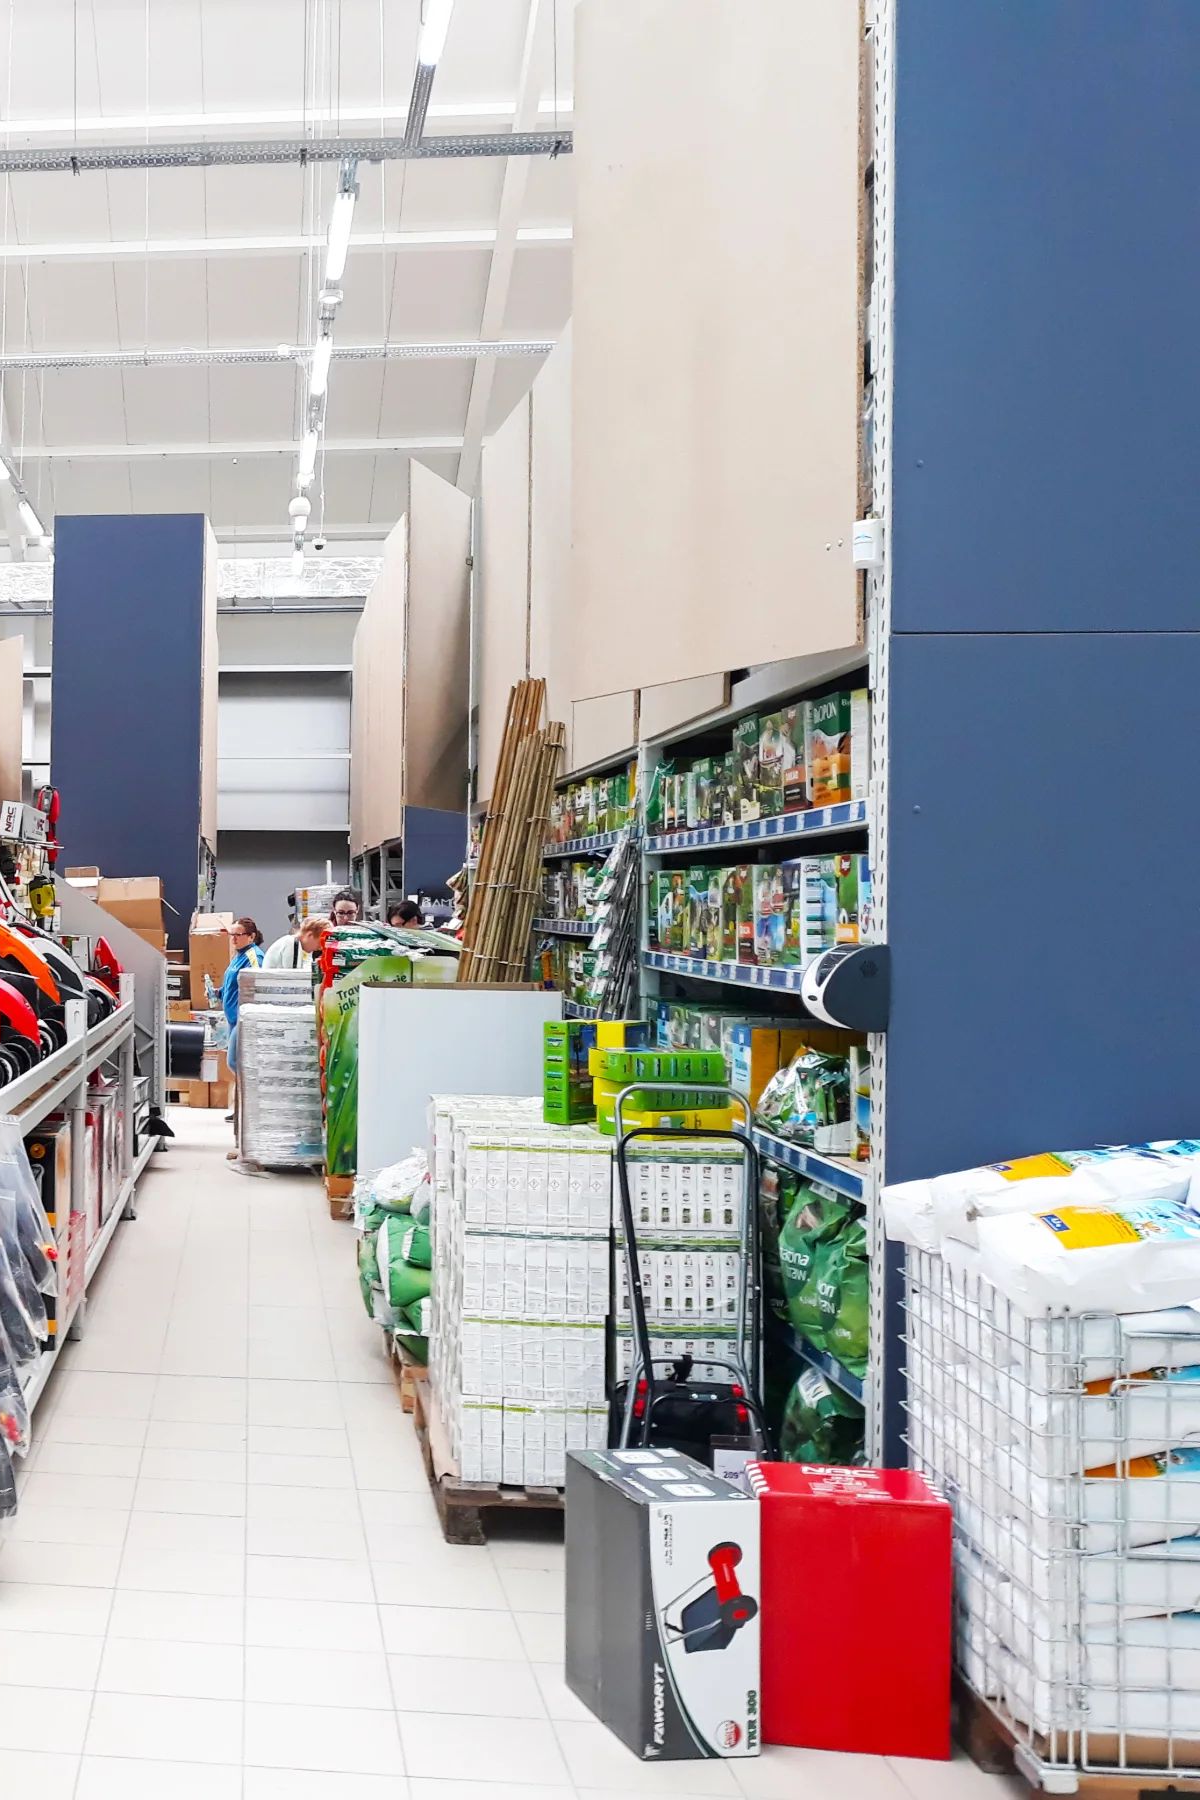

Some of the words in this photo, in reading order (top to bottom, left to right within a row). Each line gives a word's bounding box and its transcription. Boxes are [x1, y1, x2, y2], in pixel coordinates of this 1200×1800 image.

[4, 806, 14, 832] NAC
[338, 999, 357, 1016] jak
[801, 1464, 880, 1479] NAC
[653, 1662, 665, 1745] FAWORYT
